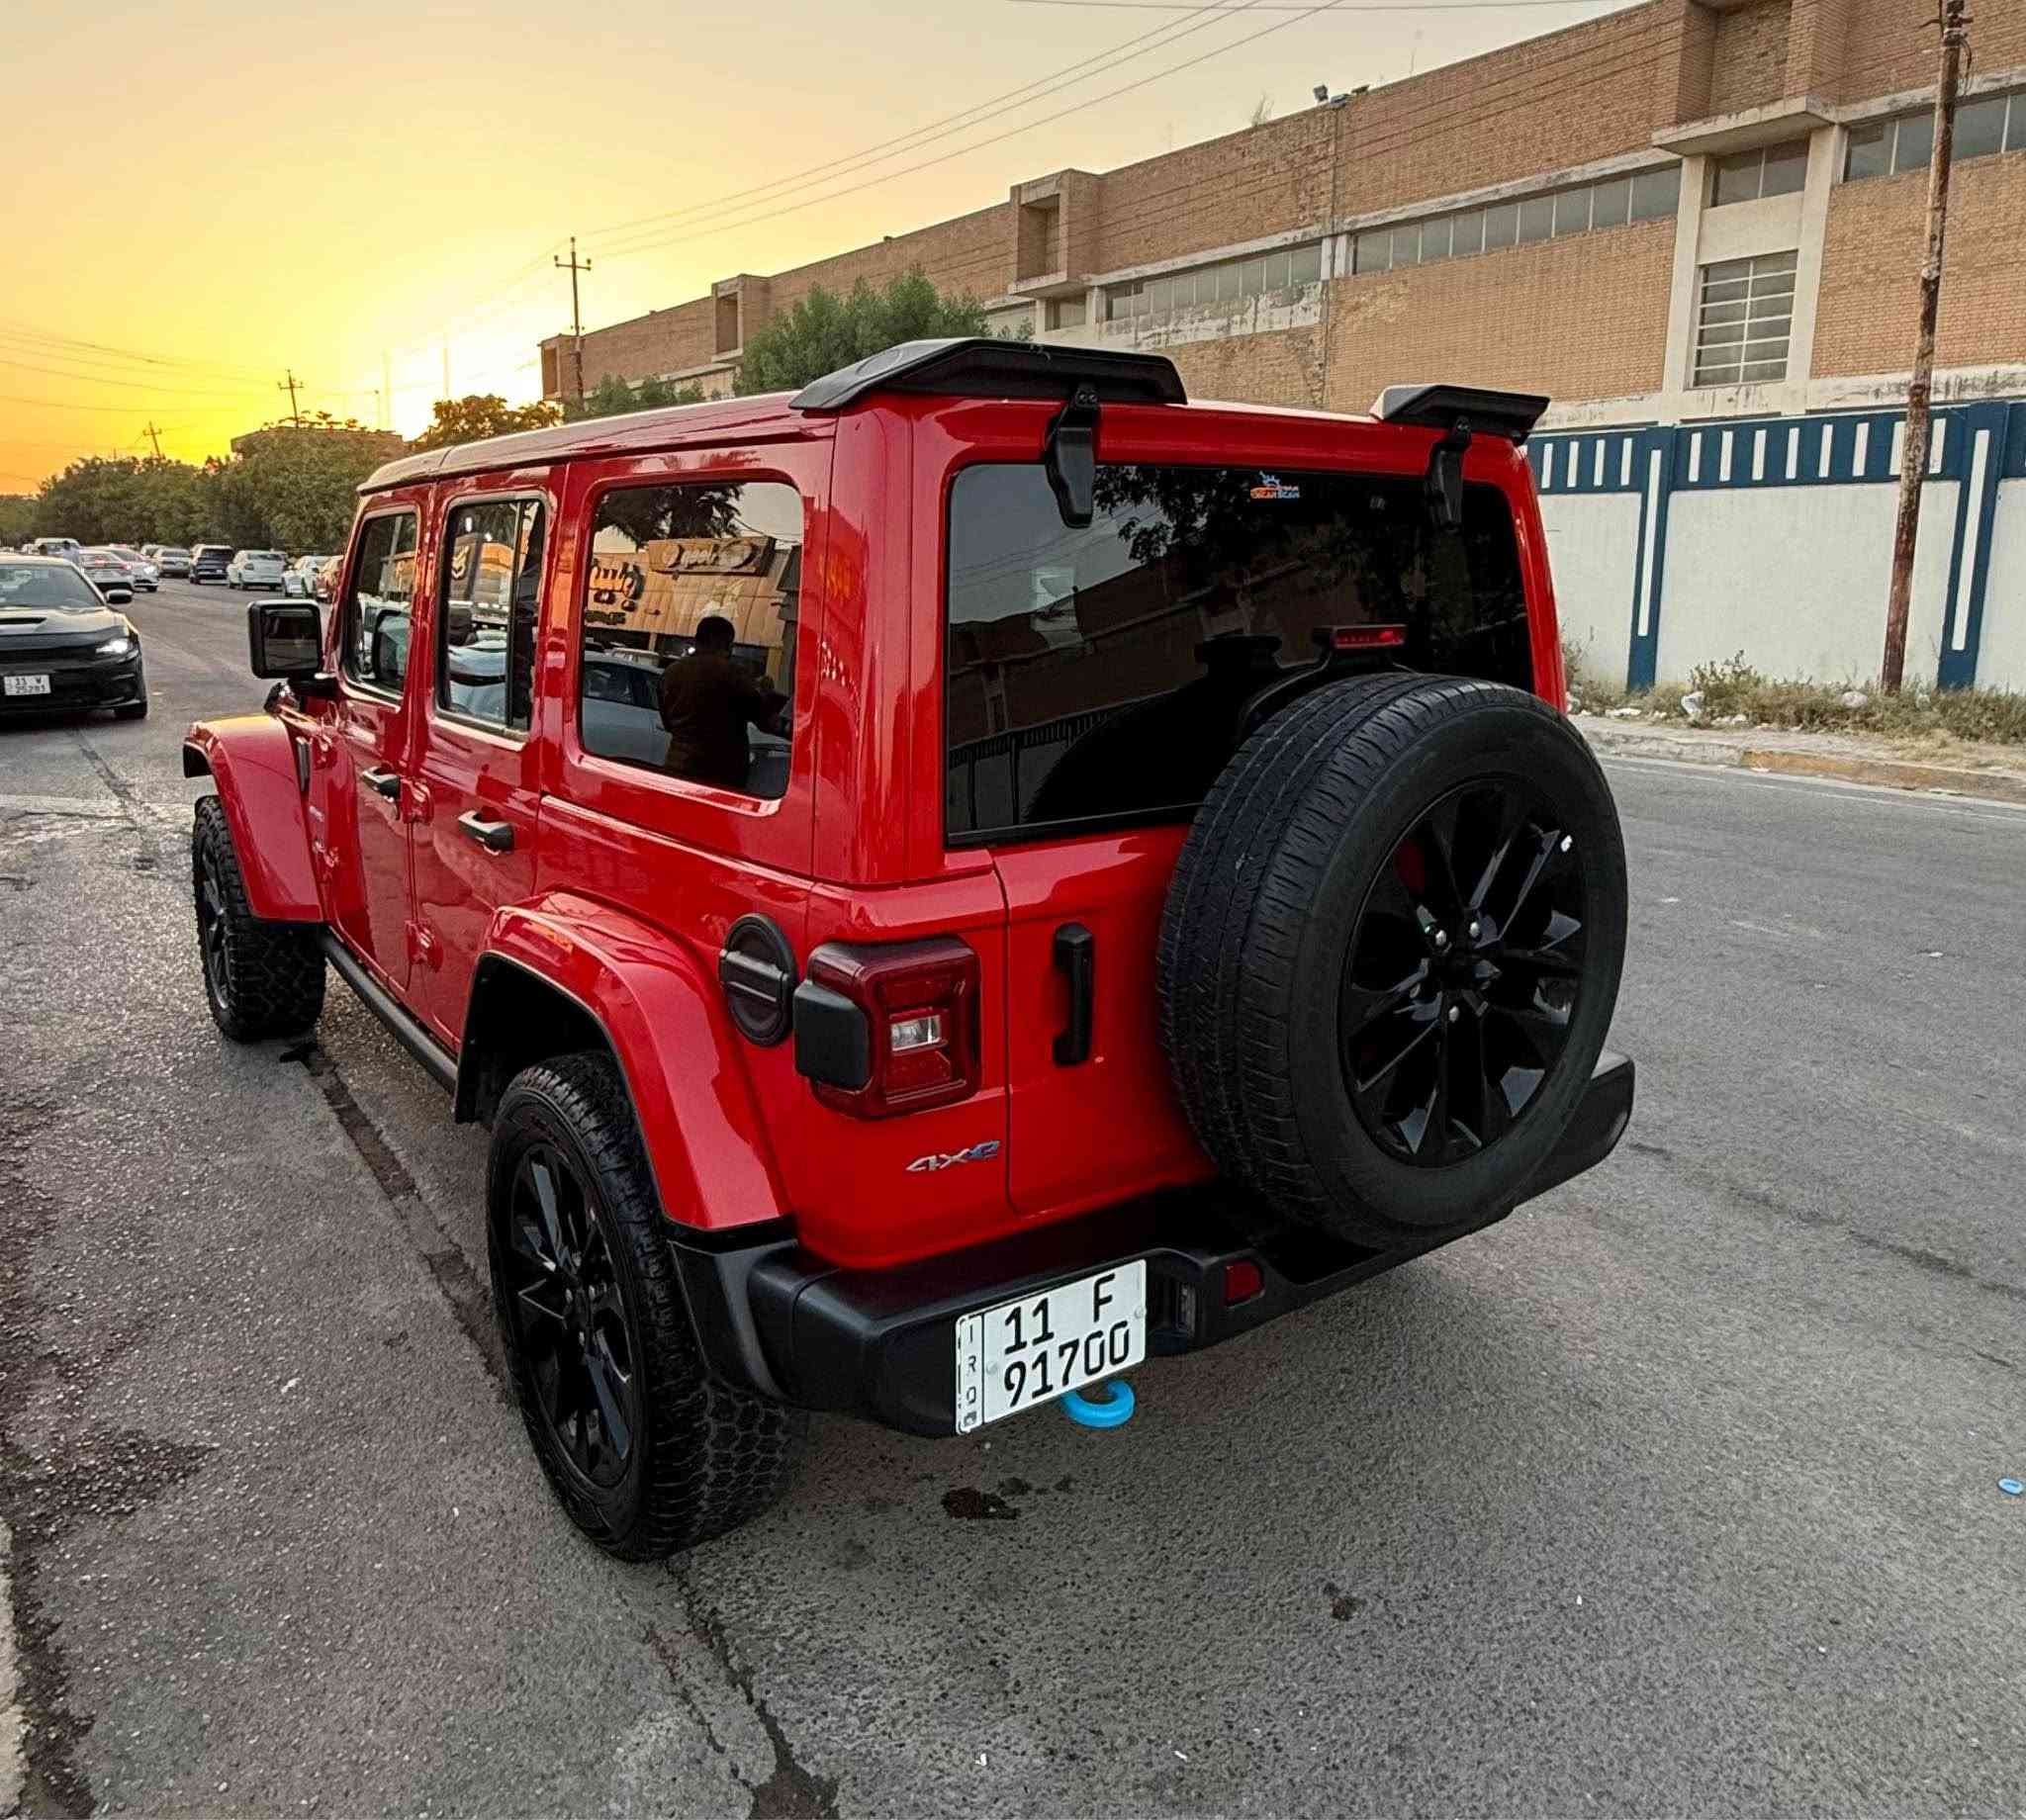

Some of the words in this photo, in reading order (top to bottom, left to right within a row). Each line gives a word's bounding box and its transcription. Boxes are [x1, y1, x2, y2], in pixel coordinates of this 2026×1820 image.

[1005, 1297, 1055, 1355] 11
[1093, 1273, 1116, 1322] F
[1004, 1320, 1130, 1409] 91700
